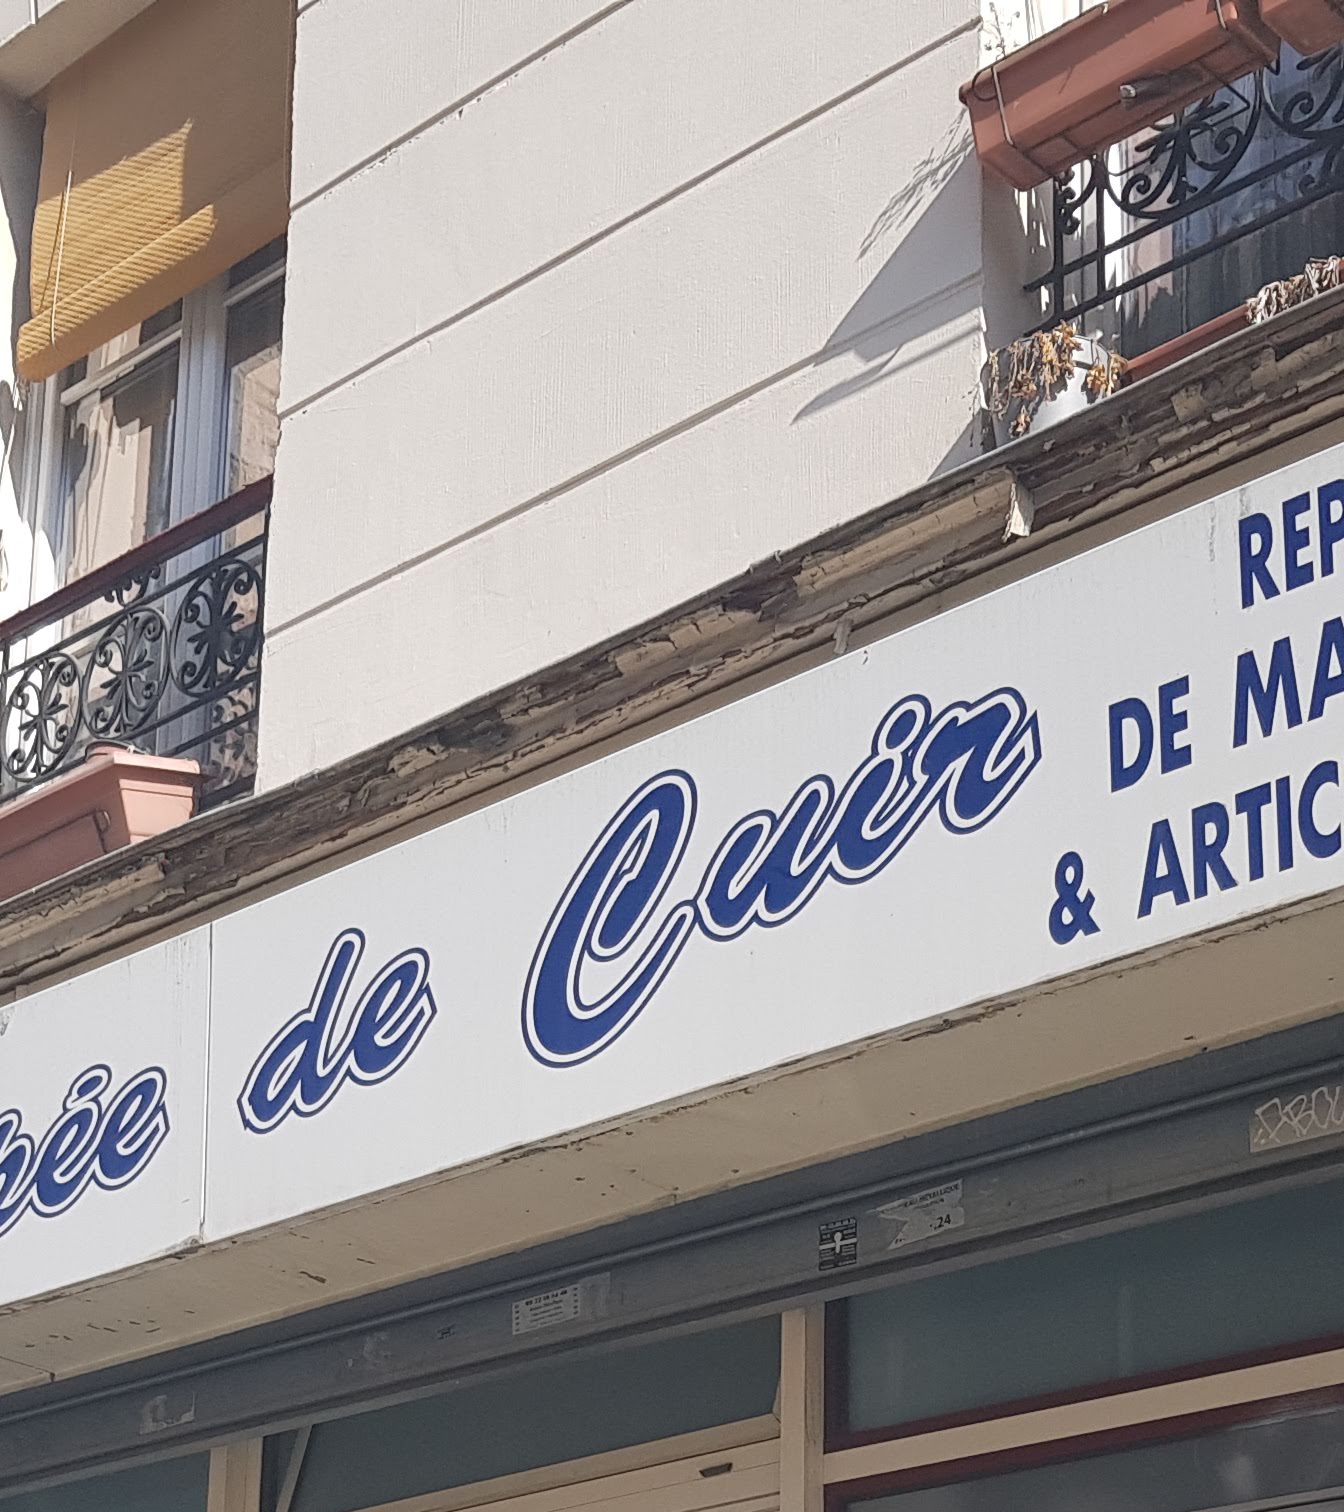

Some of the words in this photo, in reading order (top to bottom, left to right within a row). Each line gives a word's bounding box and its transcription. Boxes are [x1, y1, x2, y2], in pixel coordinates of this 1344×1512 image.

[1109, 675, 1192, 792] DE
[238, 928, 437, 1135] de
[521, 687, 1043, 1068] Cuir
[1047, 850, 1099, 944] &
